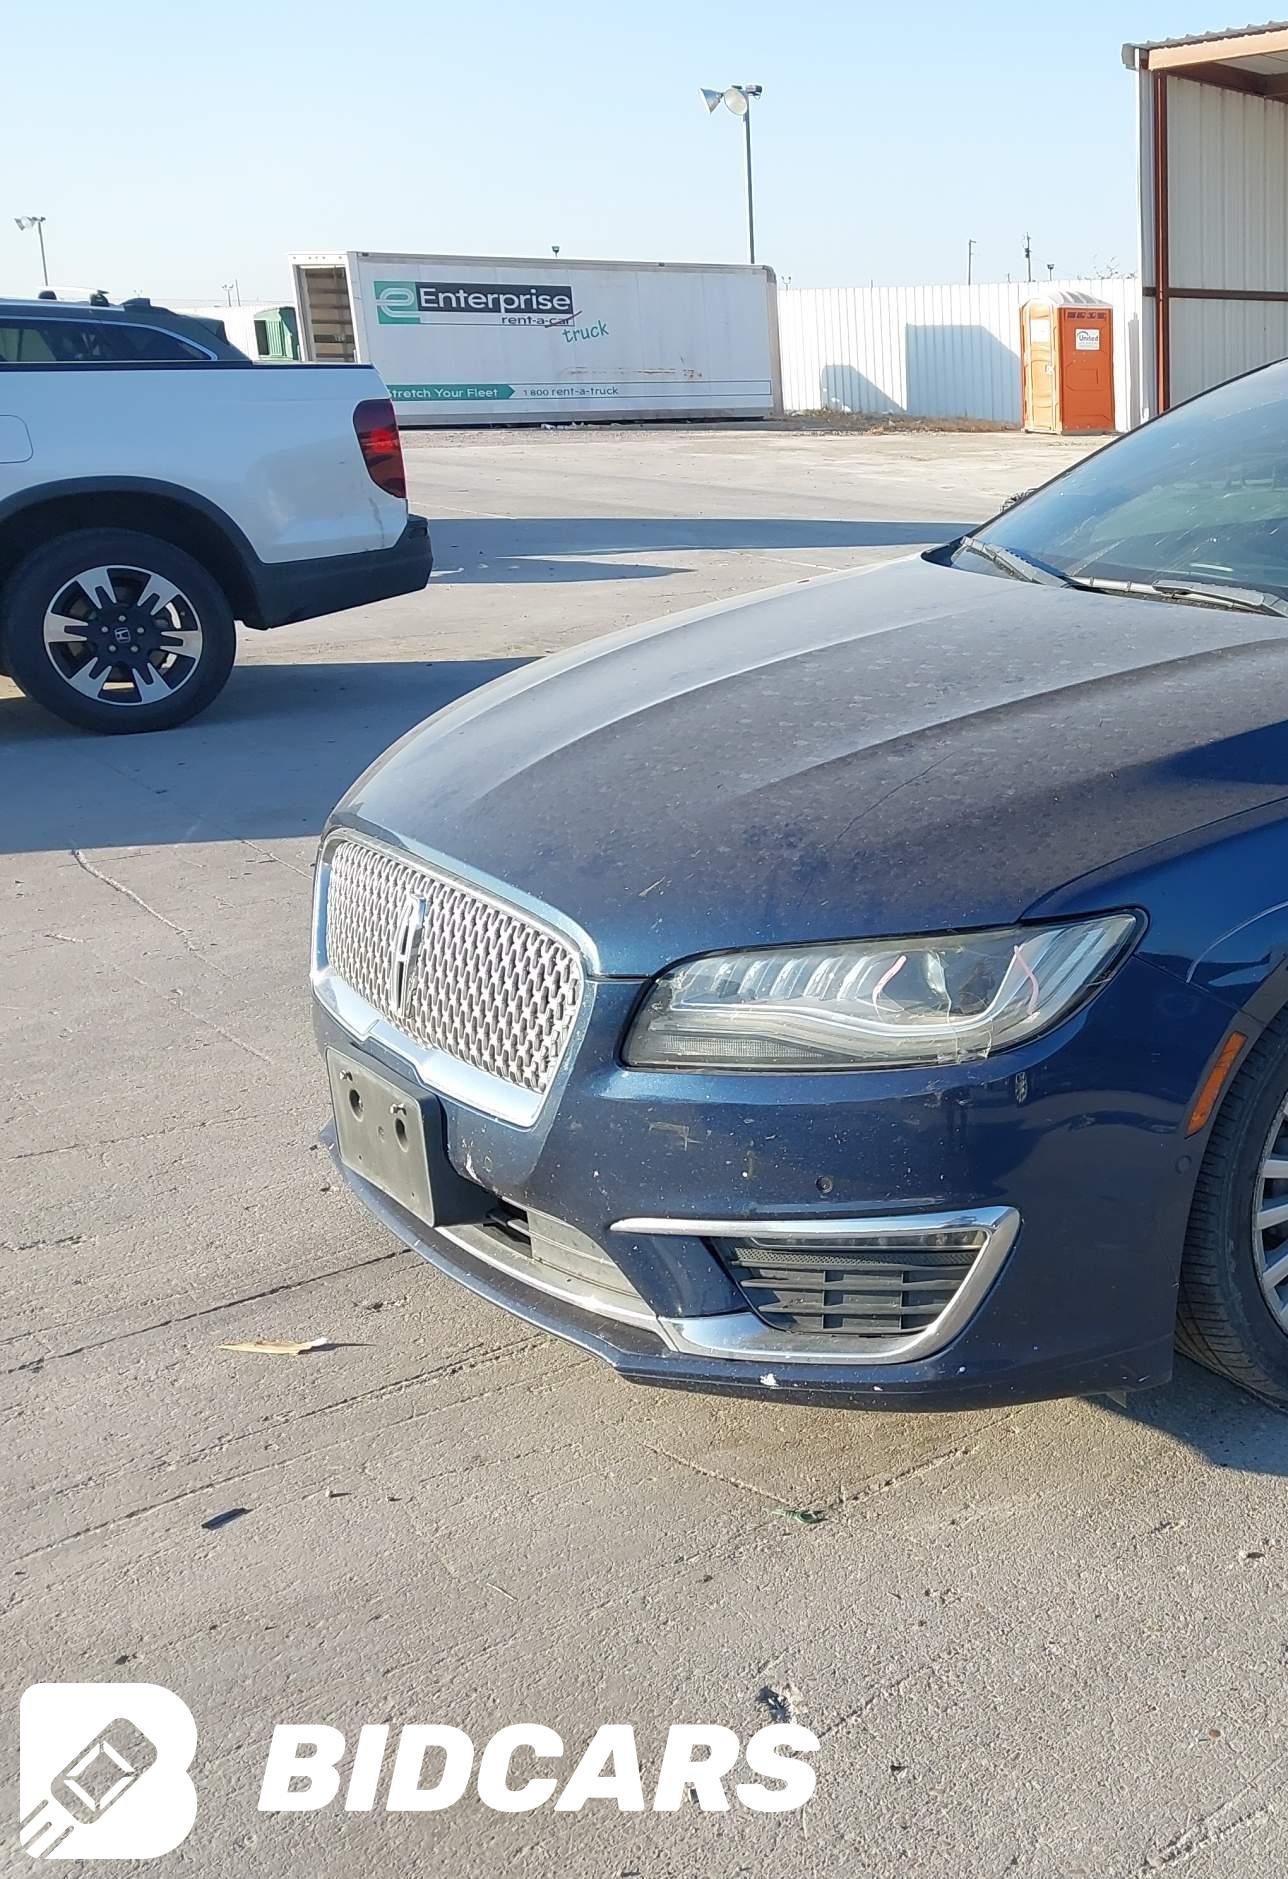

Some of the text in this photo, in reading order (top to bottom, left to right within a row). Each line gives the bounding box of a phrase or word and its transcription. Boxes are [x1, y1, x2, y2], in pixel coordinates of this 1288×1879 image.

[419, 288, 571, 313] Enterprise
[562, 319, 609, 343] truck
[434, 387, 463, 398] Your
[467, 387, 498, 398] Fleet
[530, 389, 548, 397] 800
[551, 386, 618, 396] rent-a-truck
